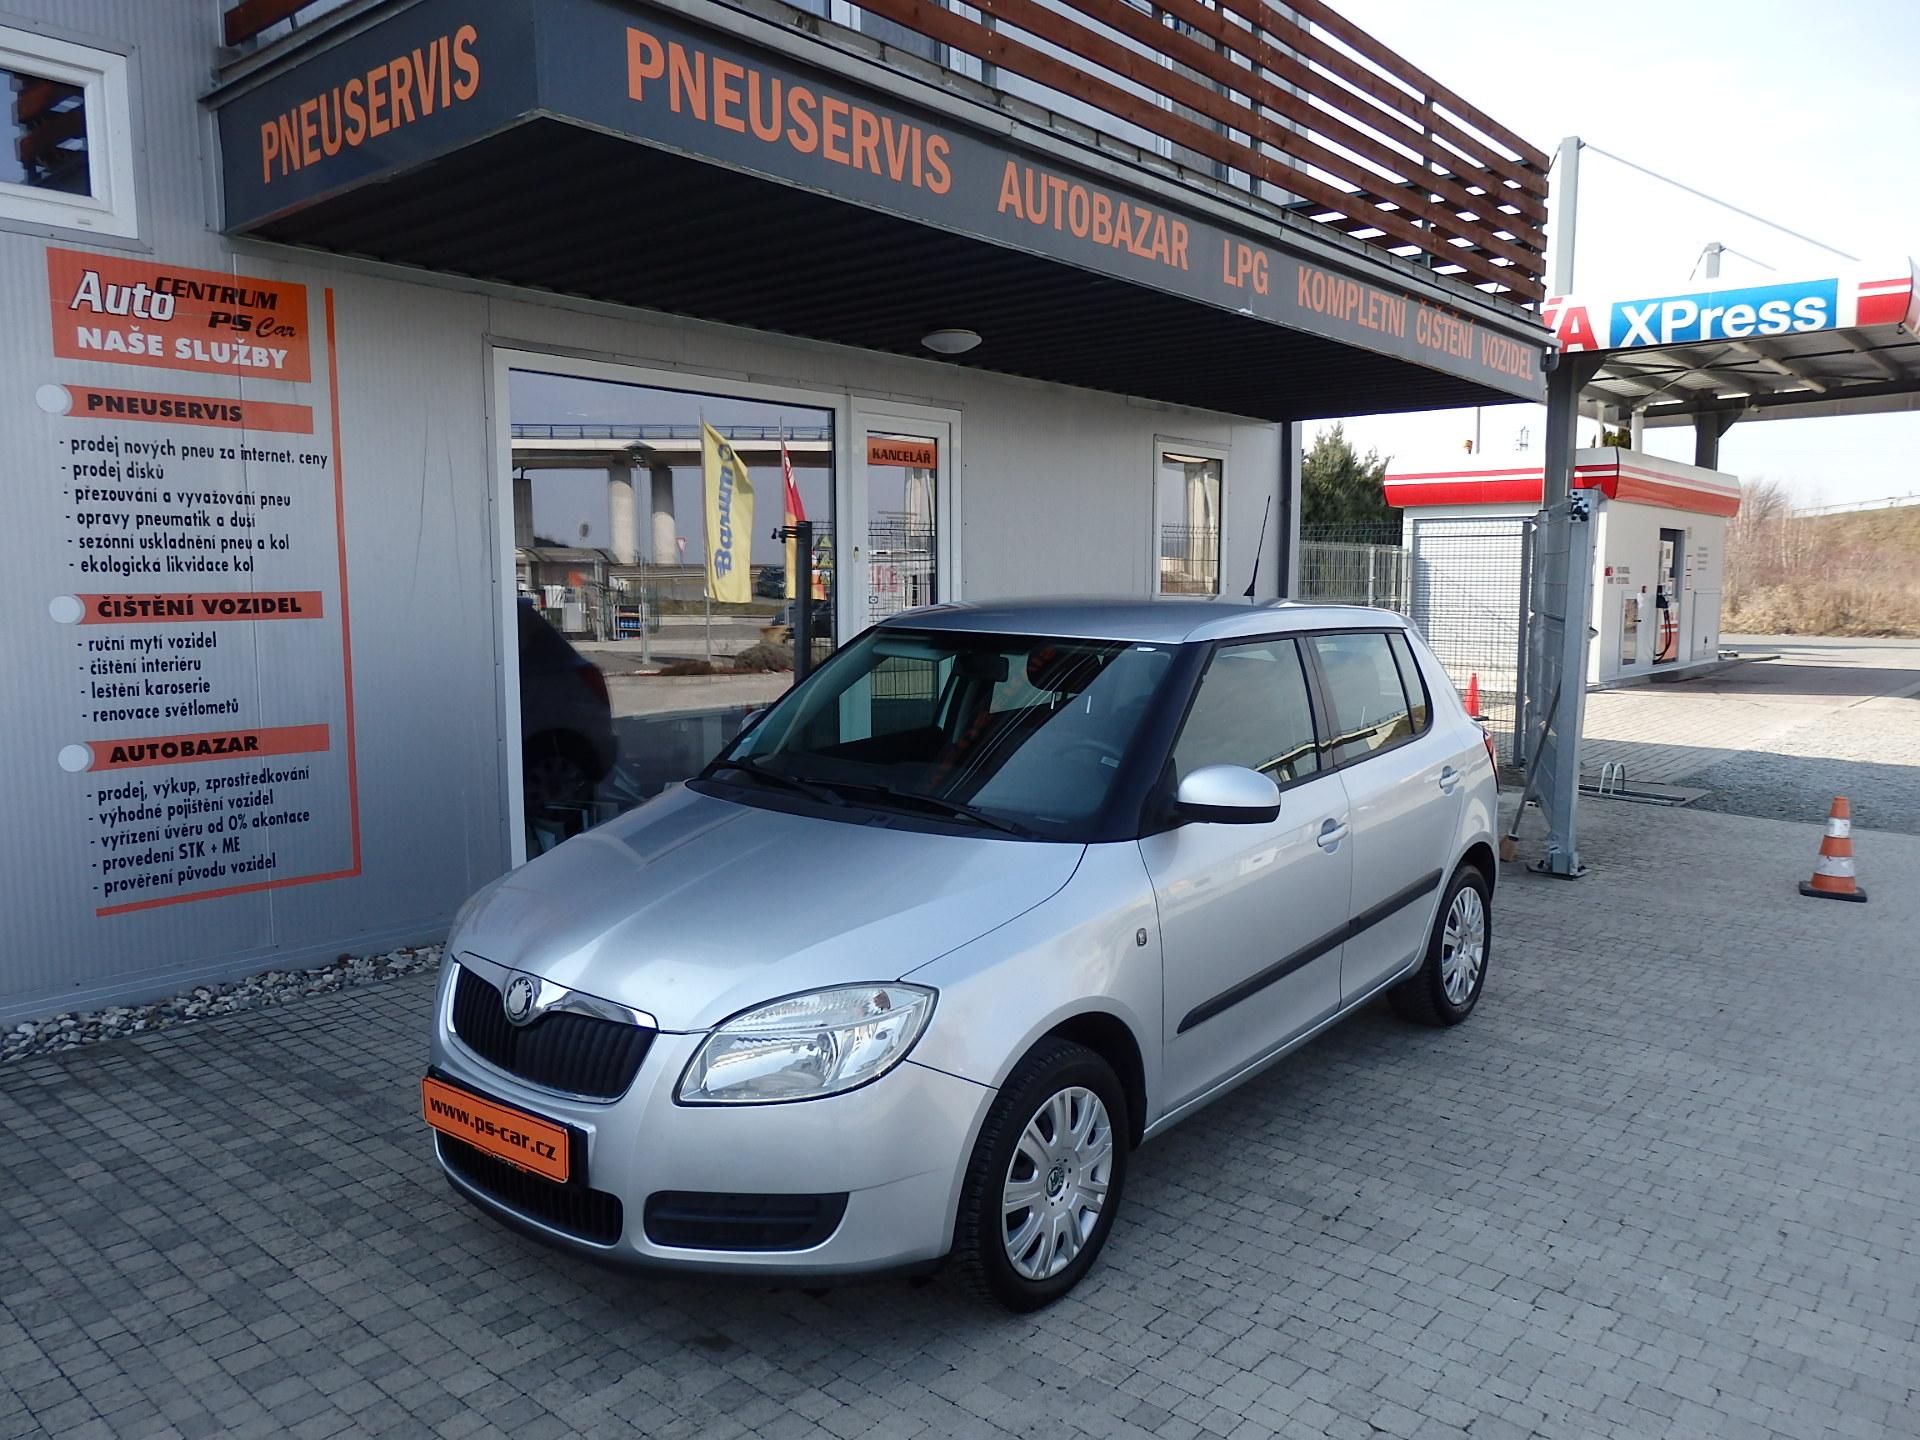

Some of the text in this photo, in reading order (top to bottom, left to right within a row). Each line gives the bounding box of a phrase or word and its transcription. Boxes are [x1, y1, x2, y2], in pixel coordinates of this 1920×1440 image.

[261, 24, 480, 185] PNEUSERVIS
[625, 27, 952, 195] PNEUSERVIS
[997, 160, 1190, 271] AUTOBAZAR
[1222, 238, 1270, 296] LPG
[1298, 265, 1409, 339] KOMPLETNÍ
[1481, 331, 1534, 382] VOZIDEL
[69, 269, 279, 322] Auto CENTRUM
[208, 310, 297, 338] PS Car
[1618, 296, 1828, 349] XPress
[77, 325, 289, 369] NAŠE SLUŽBY
[87, 393, 244, 422] PNEUSERVIS
[71, 435, 328, 470] prodej nových pneu za internet. ceny
[871, 446, 931, 465] KANCELÁŘ
[73, 459, 121, 482] prodej
[75, 485, 291, 510] přezouvání a vyvažování pneu
[77, 512, 130, 530] opravy
[136, 510, 211, 530] pneumatik
[216, 516, 225, 527] a
[713, 465, 734, 581] Barum
[139, 532, 216, 550] uskladnění
[221, 538, 253, 554] pneu
[257, 540, 265, 550] a
[270, 533, 290, 550] kol
[81, 554, 254, 577] ekologická likvidace kol
[97, 594, 302, 618] ČIŠTĚNÍ VOZIDEL
[88, 631, 217, 655] ruční mytí vozidel
[90, 655, 201, 675] čištění interiéru
[91, 677, 211, 699] leštění karoserie
[93, 698, 239, 722] renovace světlometů
[109, 735, 259, 763] AUTOBAZAR
[98, 765, 310, 806] prodej, výkup, zprostředkování
[100, 788, 274, 828] výhodné pojištění vozidel
[101, 811, 310, 851] vyřízení úvěru od 0% akontace
[103, 836, 241, 875] provedení STK + ME
[104, 852, 276, 897] prověření původu vozidel
[429, 1096, 557, 1162] www.ps-car.cz
